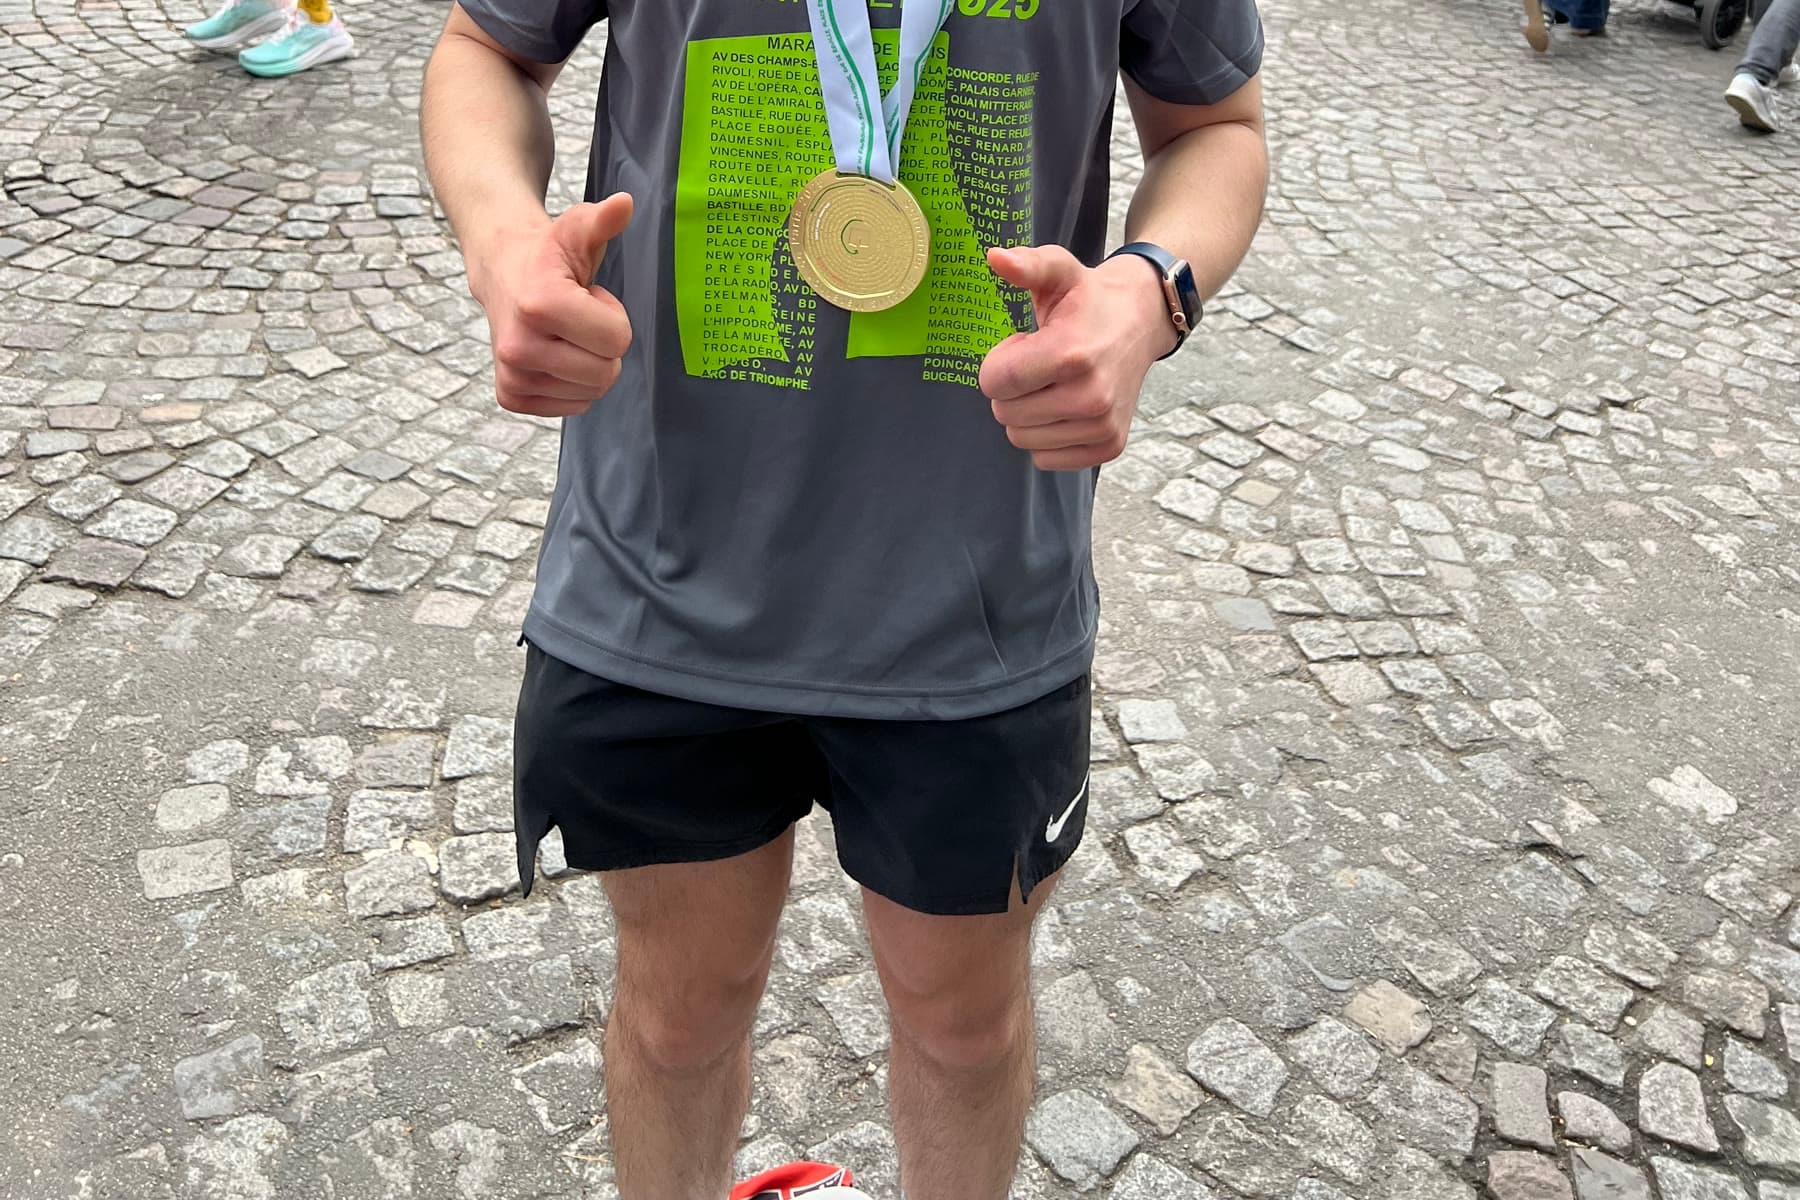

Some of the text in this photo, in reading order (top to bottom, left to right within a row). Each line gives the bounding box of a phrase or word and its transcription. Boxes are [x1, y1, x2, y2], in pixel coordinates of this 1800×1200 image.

[767, 36, 815, 52] MARA
[712, 51, 729, 62] AV
[730, 53, 754, 64] DES
[757, 55, 818, 69] CHAMPS-E
[947, 67, 1014, 85] CONCORDE,
[712, 65, 755, 79] RIVOLI,
[758, 70, 782, 80] RUE
[785, 71, 801, 81] DE
[960, 83, 1000, 97] PALAIS
[711, 92, 735, 104] RUE
[738, 95, 755, 105] DE
[757, 96, 811, 109] L'AMIRAL
[920, 105, 937, 115] DE
[939, 105, 979, 123] RIVOLI,
[981, 114, 1017, 125] PLACE
[712, 79, 727, 89] AV
[729, 80, 745, 90] DE
[747, 81, 801, 96] L'OPÉRA,
[914, 91, 949, 104] UVRE,
[951, 94, 978, 107] QUAI
[711, 105, 766, 120] BASTILLE,
[769, 110, 792, 121] RUE
[795, 111, 811, 123] DU
[906, 117, 966, 133] T-ANTOINE,
[968, 123, 988, 137] RUE
[990, 127, 1008, 139] DE
[711, 119, 752, 132] PLACE
[930, 132, 972, 147] PLACE
[976, 140, 1025, 153] RENARD,
[710, 132, 790, 148] DAUMESNIL,
[924, 144, 966, 160] LOUIS,
[971, 150, 1024, 167] CHÂTEAU
[710, 146, 782, 162] VINCENNES,
[785, 151, 825, 164] ROUTE
[900, 158, 929, 170] MIDE,
[932, 159, 972, 173] ROUTE
[974, 164, 989, 177] DE
[990, 168, 1006, 180] LA
[708, 173, 783, 188] GRAVELLE,
[921, 186, 1010, 209] CHARENTON,
[709, 159, 753, 173] ROUTE
[756, 163, 773, 173] DE
[777, 163, 793, 174] LA
[943, 173, 960, 184] DU
[964, 175, 1012, 195] PESAGE,
[708, 187, 783, 201] DAUMESNIL,
[931, 197, 966, 213] LYON,
[970, 203, 1008, 221] PLACE
[1012, 209, 1025, 222] DE
[770, 204, 787, 213] BD
[935, 215, 949, 226] 4,
[966, 215, 1001, 233] QUAI
[706, 225, 724, 234] DE
[727, 225, 743, 235] LA
[935, 241, 965, 252] VOIE
[706, 238, 748, 248] PLACE
[751, 240, 768, 249] DE
[934, 254, 966, 264] TOUR
[936, 227, 1002, 248] POMPIDOU,
[706, 250, 734, 261] NEW
[738, 252, 776, 265] YORK,
[932, 267, 947, 277] DE
[951, 268, 1008, 289] VARSOVIE,
[705, 276, 722, 286] DE
[724, 277, 738, 287] LA
[742, 279, 781, 293] RADIO,
[783, 285, 800, 295] AV
[930, 293, 1012, 316] VERSAILLES,
[931, 280, 991, 298] KENNEDY,
[704, 290, 782, 307] EXELMANS,
[798, 299, 817, 310] BD
[928, 305, 998, 326] D'AUTEUIL,
[704, 303, 1004, 341] DE LA REINE MARGUERITE,
[703, 316, 796, 336] L'HIPPODROME,
[798, 326, 816, 336] AV
[927, 332, 974, 347] INGRES,
[703, 330, 720, 339] DE
[724, 330, 739, 340] LA
[743, 332, 795, 349] MUETTE,
[798, 339, 815, 349] AV
[702, 356, 715, 366] V.
[718, 357, 767, 372] HUGO,
[794, 365, 813, 377] AV
[797, 352, 814, 363] AV
[924, 357, 979, 374] POINCAR
[701, 369, 812, 391] ARC DE TRIOMPHE.
